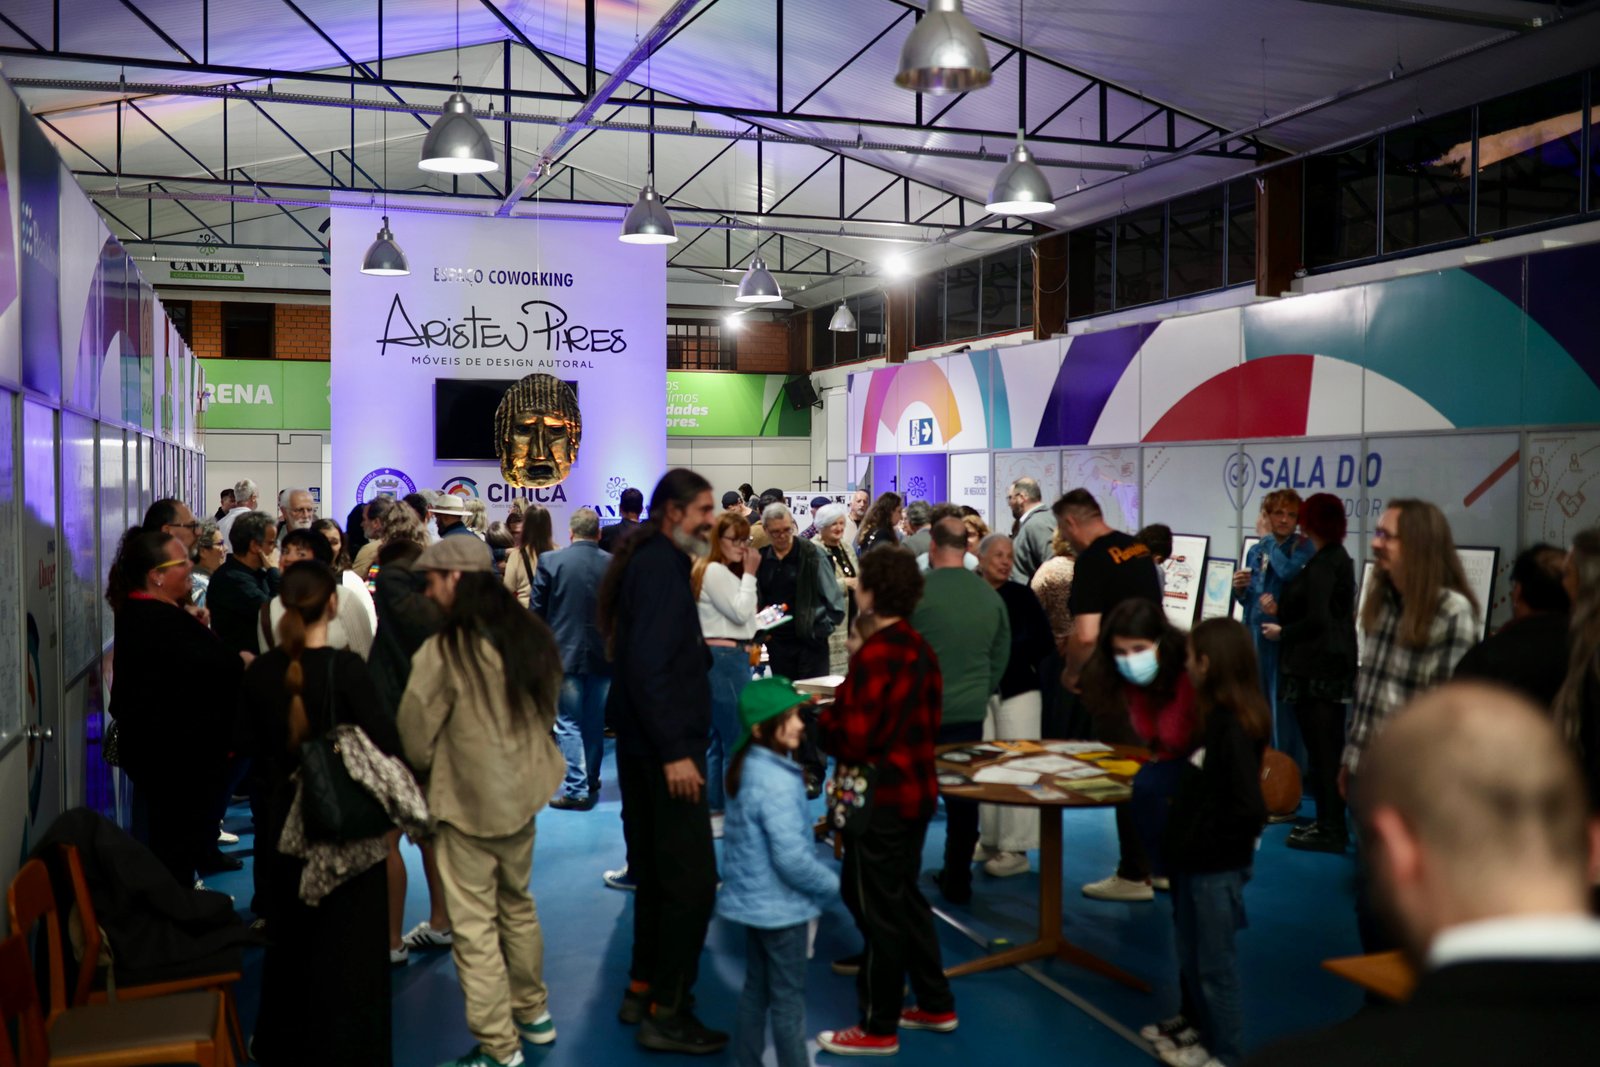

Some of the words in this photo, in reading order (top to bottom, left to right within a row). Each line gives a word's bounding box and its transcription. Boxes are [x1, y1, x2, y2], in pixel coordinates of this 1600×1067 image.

[433, 267, 483, 287] ESPAÇO
[488, 270, 574, 288] COWORKING
[411, 353, 461, 366] MÓVEIS
[466, 357, 481, 366] DE
[486, 358, 534, 367] DESIGN
[538, 359, 594, 369] AUTORAL
[1259, 455, 1325, 489] SALA
[1336, 452, 1383, 488] DO
